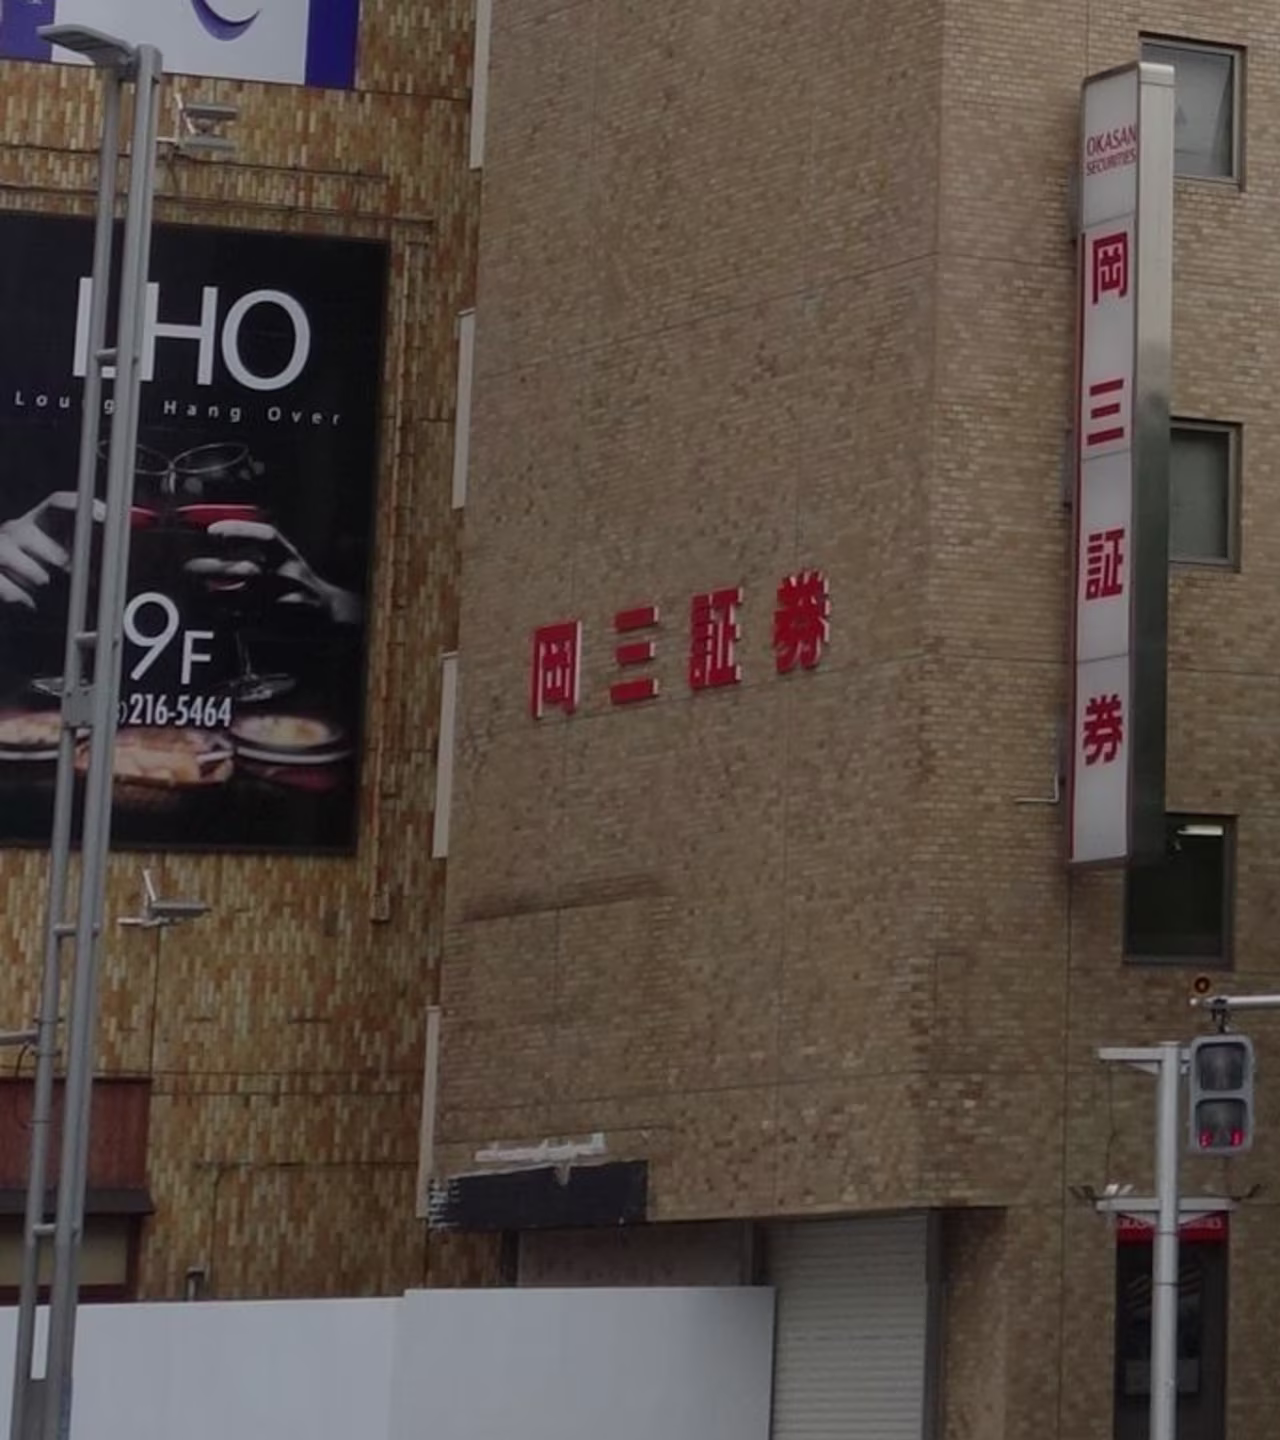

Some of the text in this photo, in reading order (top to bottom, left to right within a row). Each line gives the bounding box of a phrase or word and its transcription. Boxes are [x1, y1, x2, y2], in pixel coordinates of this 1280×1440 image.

[1087, 125, 1136, 156] OKASAN
[73, 277, 310, 391] LHO
[15, 390, 341, 426] Loug Hang Over
[1082, 231, 1128, 766] 岡三証券
[124, 591, 214, 685] 9F
[530, 568, 830, 722] 岡三証券
